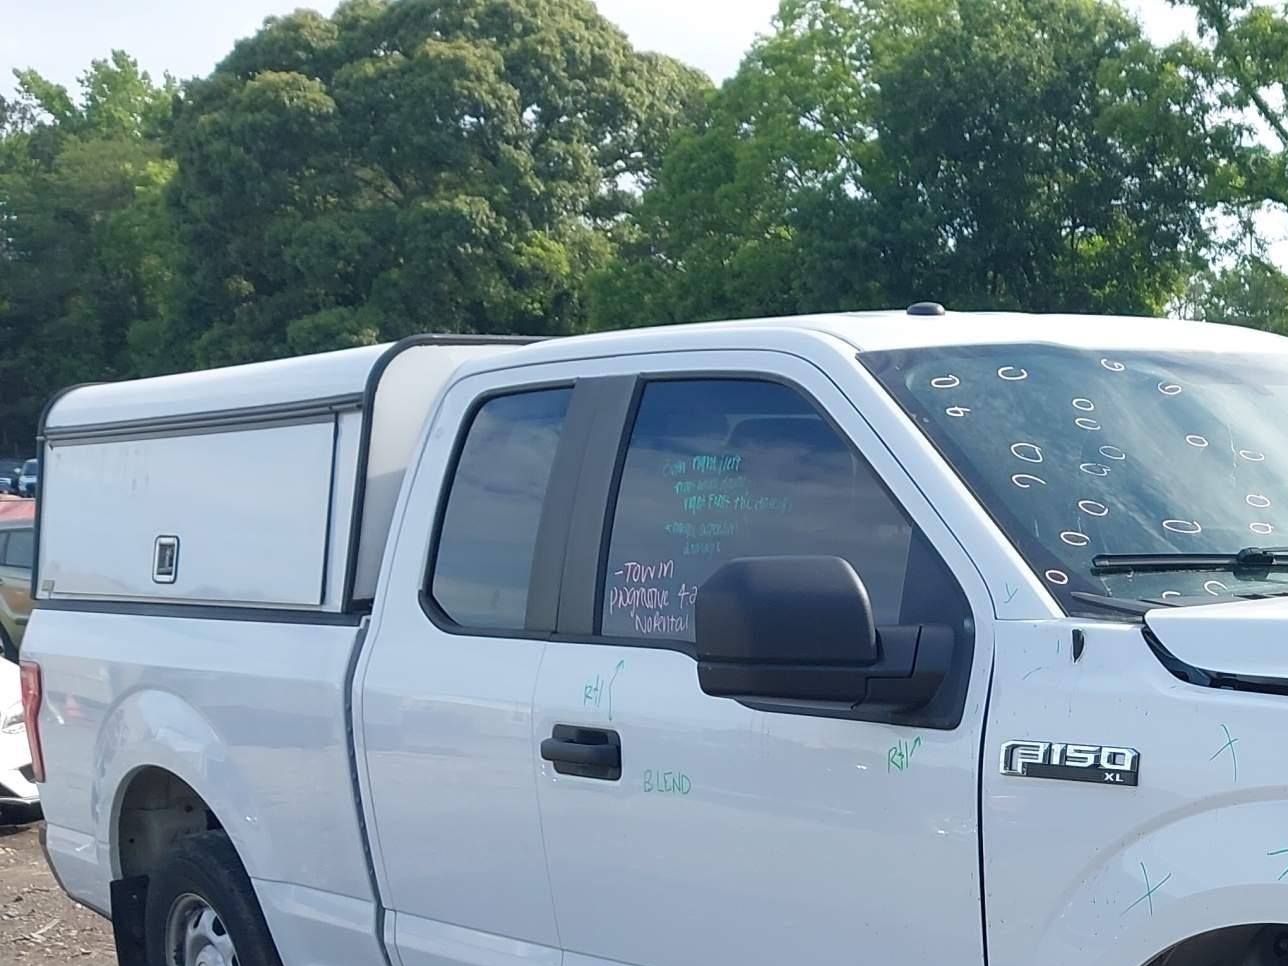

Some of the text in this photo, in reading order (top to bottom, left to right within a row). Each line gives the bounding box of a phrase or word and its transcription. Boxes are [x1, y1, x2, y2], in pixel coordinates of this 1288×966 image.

[999, 738, 1140, 776] F150
[643, 768, 691, 796] BLEND
[1103, 771, 1125, 783] XL
